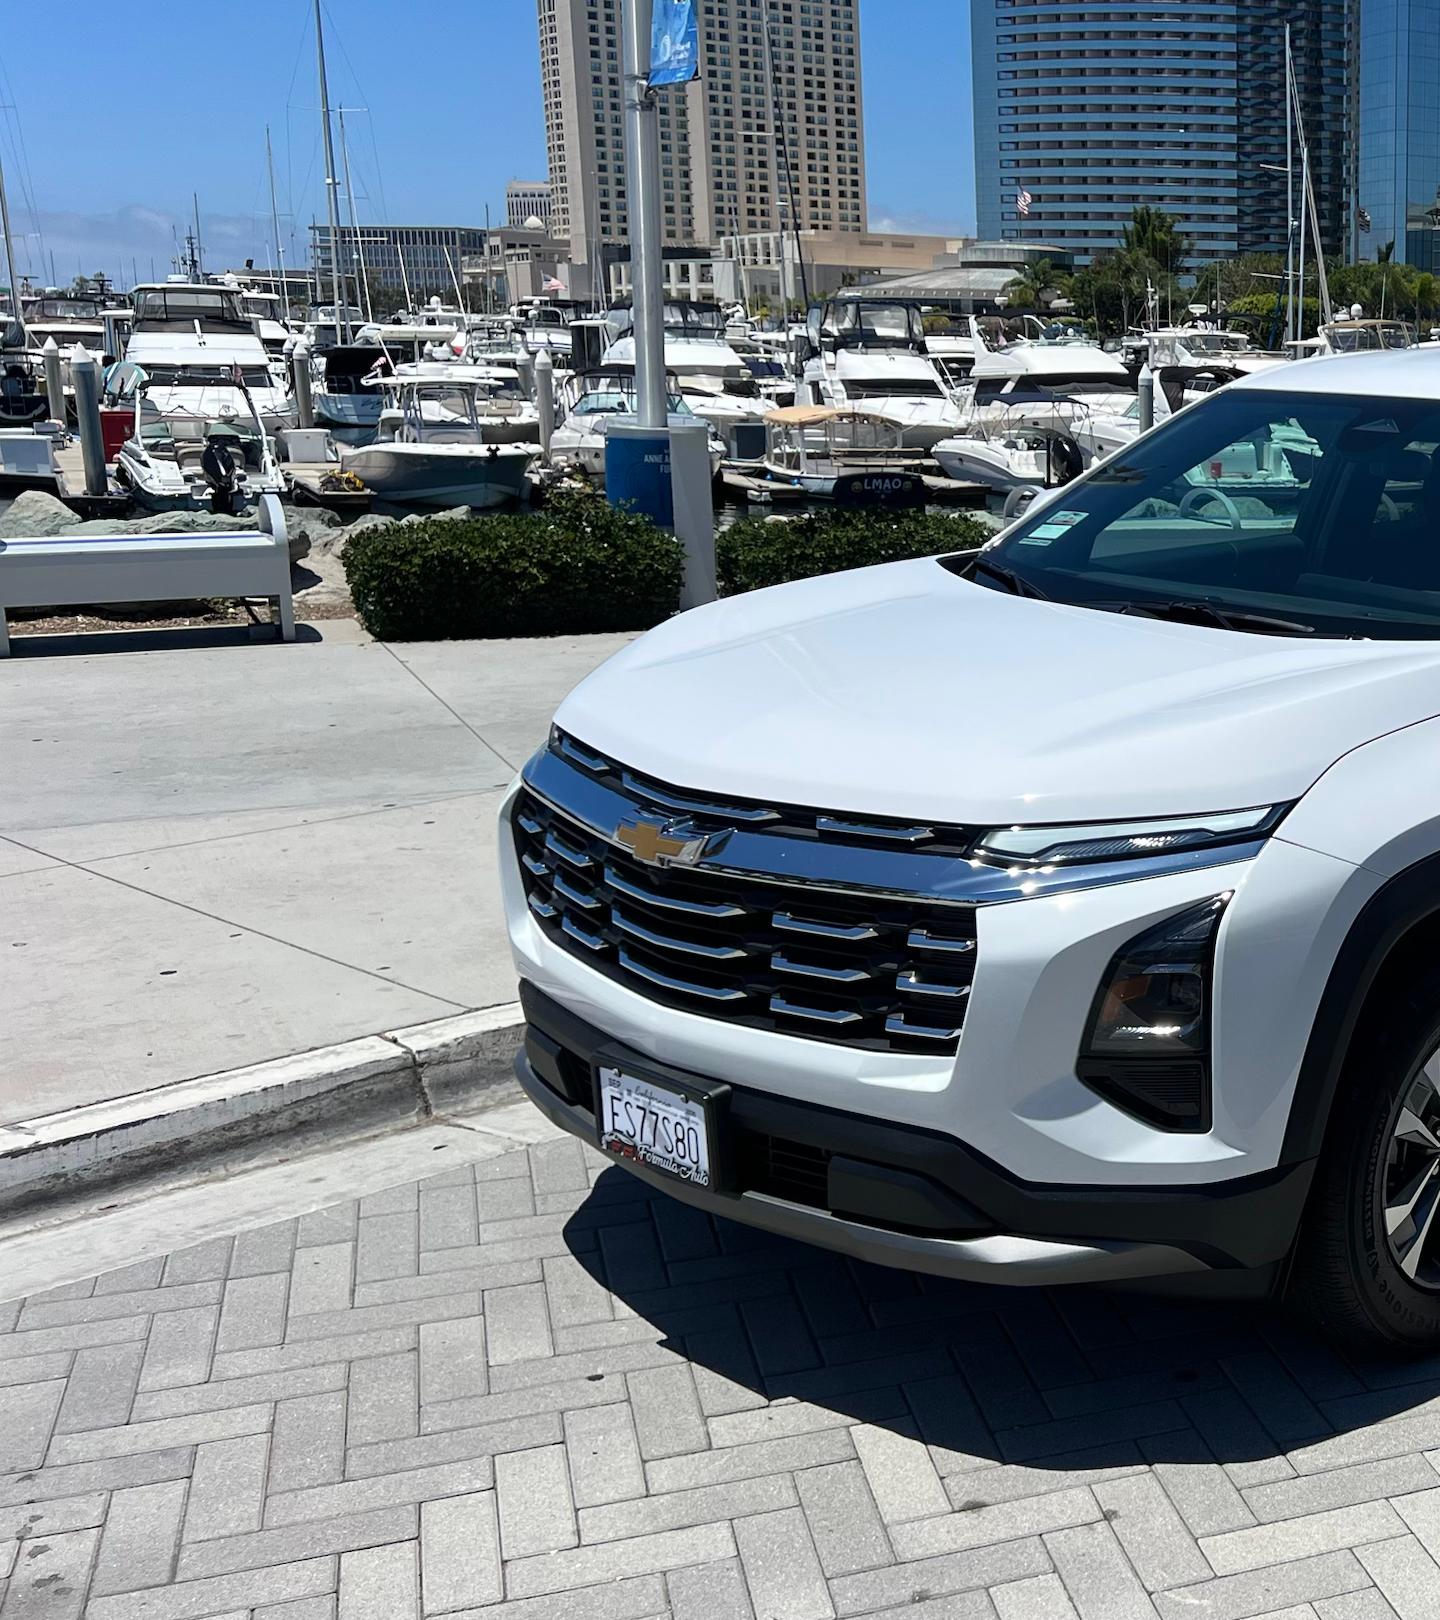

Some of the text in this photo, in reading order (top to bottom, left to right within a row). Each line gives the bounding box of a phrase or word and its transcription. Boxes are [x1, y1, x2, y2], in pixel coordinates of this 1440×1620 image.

[644, 454, 663, 463] ANNE
[864, 478, 902, 490] LMAO
[610, 1094, 700, 1165] ES77S80
[638, 1142, 679, 1174] Formula
[678, 1164, 710, 1187] Auto
